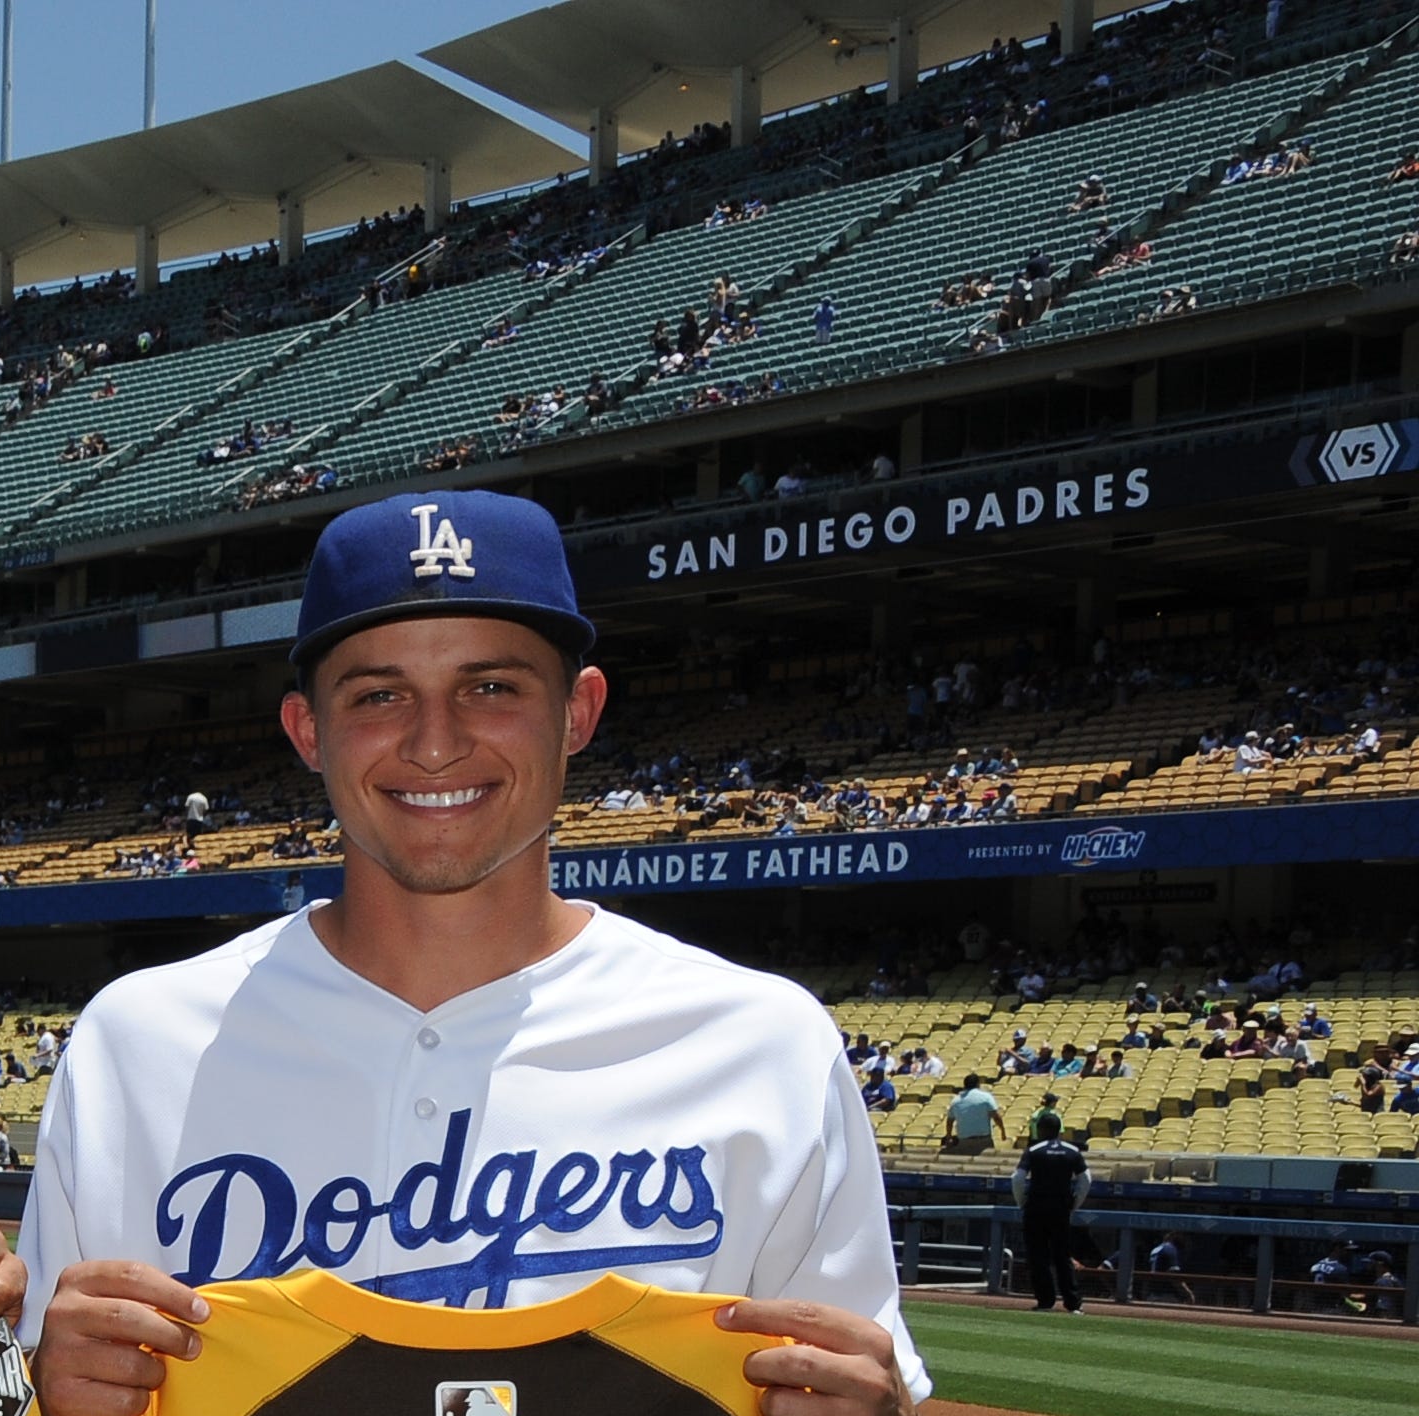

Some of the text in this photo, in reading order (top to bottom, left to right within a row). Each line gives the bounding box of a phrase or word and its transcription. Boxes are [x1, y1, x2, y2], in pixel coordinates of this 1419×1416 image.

[1341, 442, 1376, 468] VS
[410, 504, 475, 578] LA
[648, 468, 1151, 580] SAN DIEGO PADRES
[549, 842, 909, 890] ERNÁNDEZ FATHEAD
[968, 844, 1053, 859] PRESENTED BY
[1062, 831, 1146, 861] HI-CHEW
[157, 1108, 723, 1308] Dodgers
